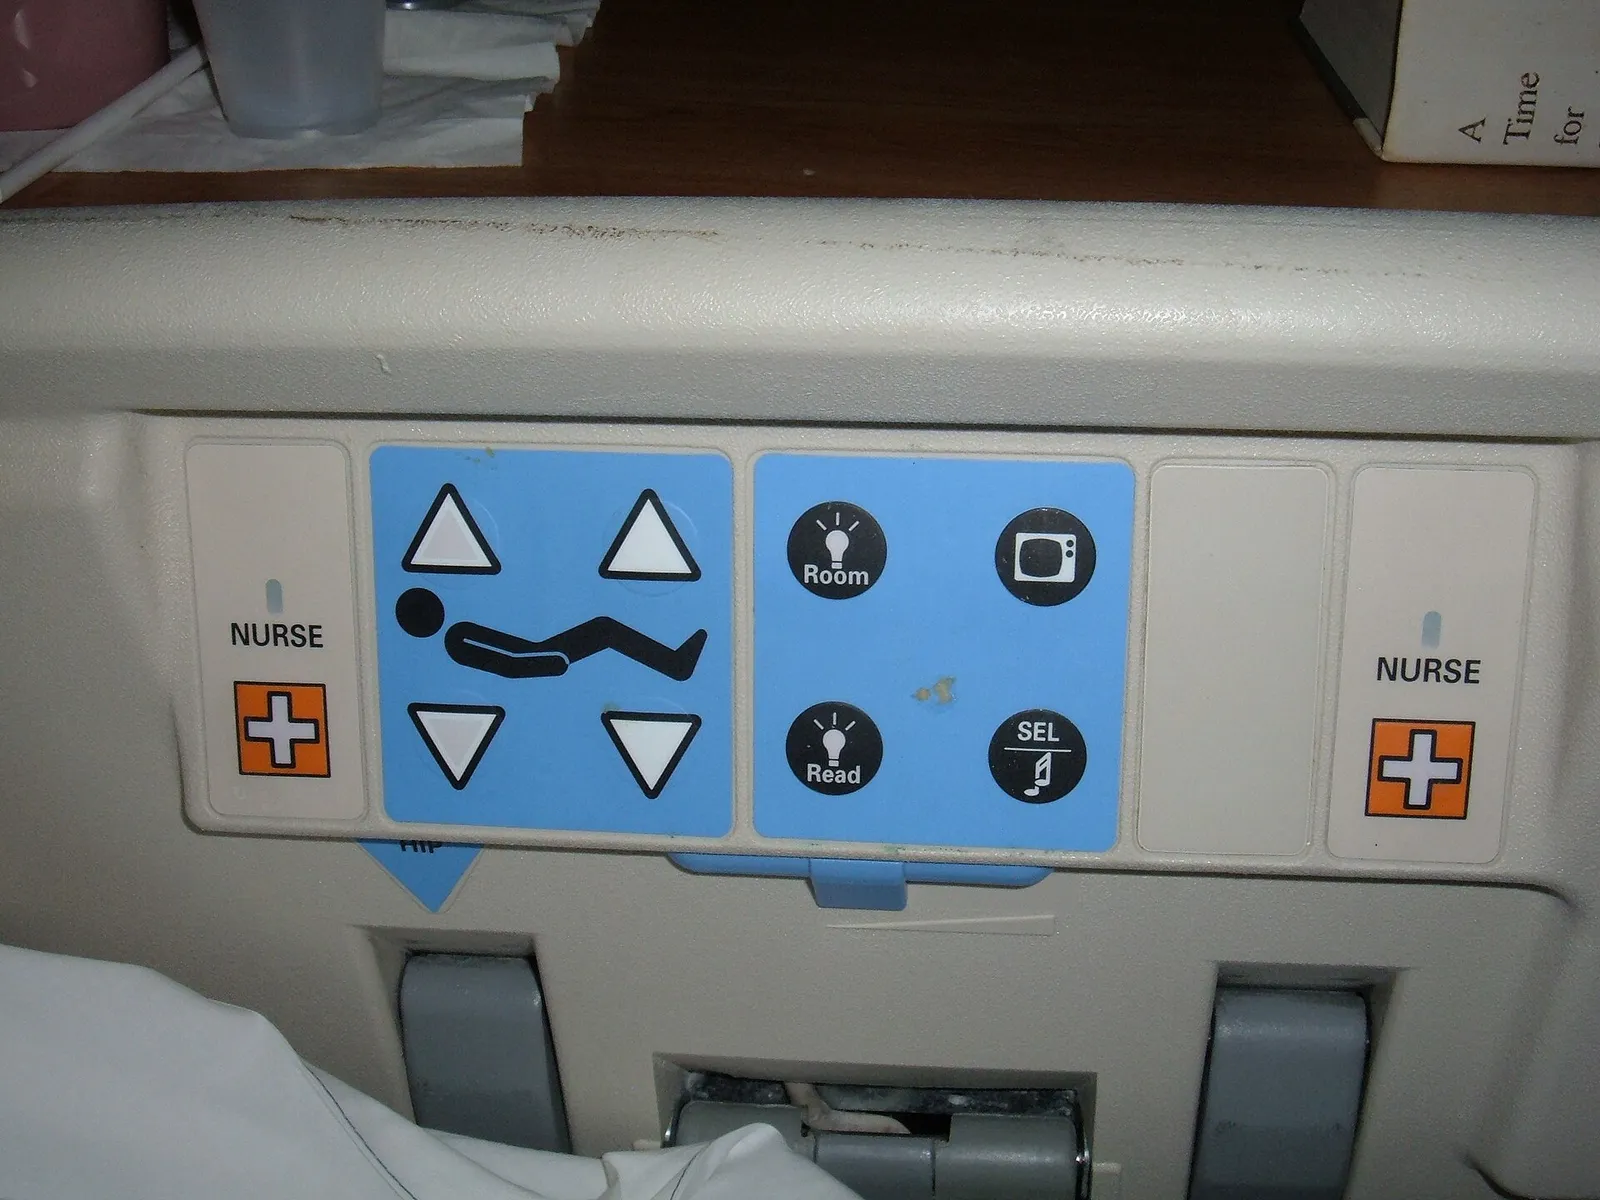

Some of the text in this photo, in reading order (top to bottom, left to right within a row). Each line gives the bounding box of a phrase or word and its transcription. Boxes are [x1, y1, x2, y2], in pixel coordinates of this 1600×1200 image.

[1503, 72, 1540, 145] Time
[1458, 117, 1486, 143] A
[1554, 107, 1585, 145] for
[803, 564, 869, 586] Room
[231, 622, 324, 648] NURSE
[1376, 656, 1481, 684] NURSE
[1017, 721, 1060, 742] SEL
[806, 763, 861, 784] Read
